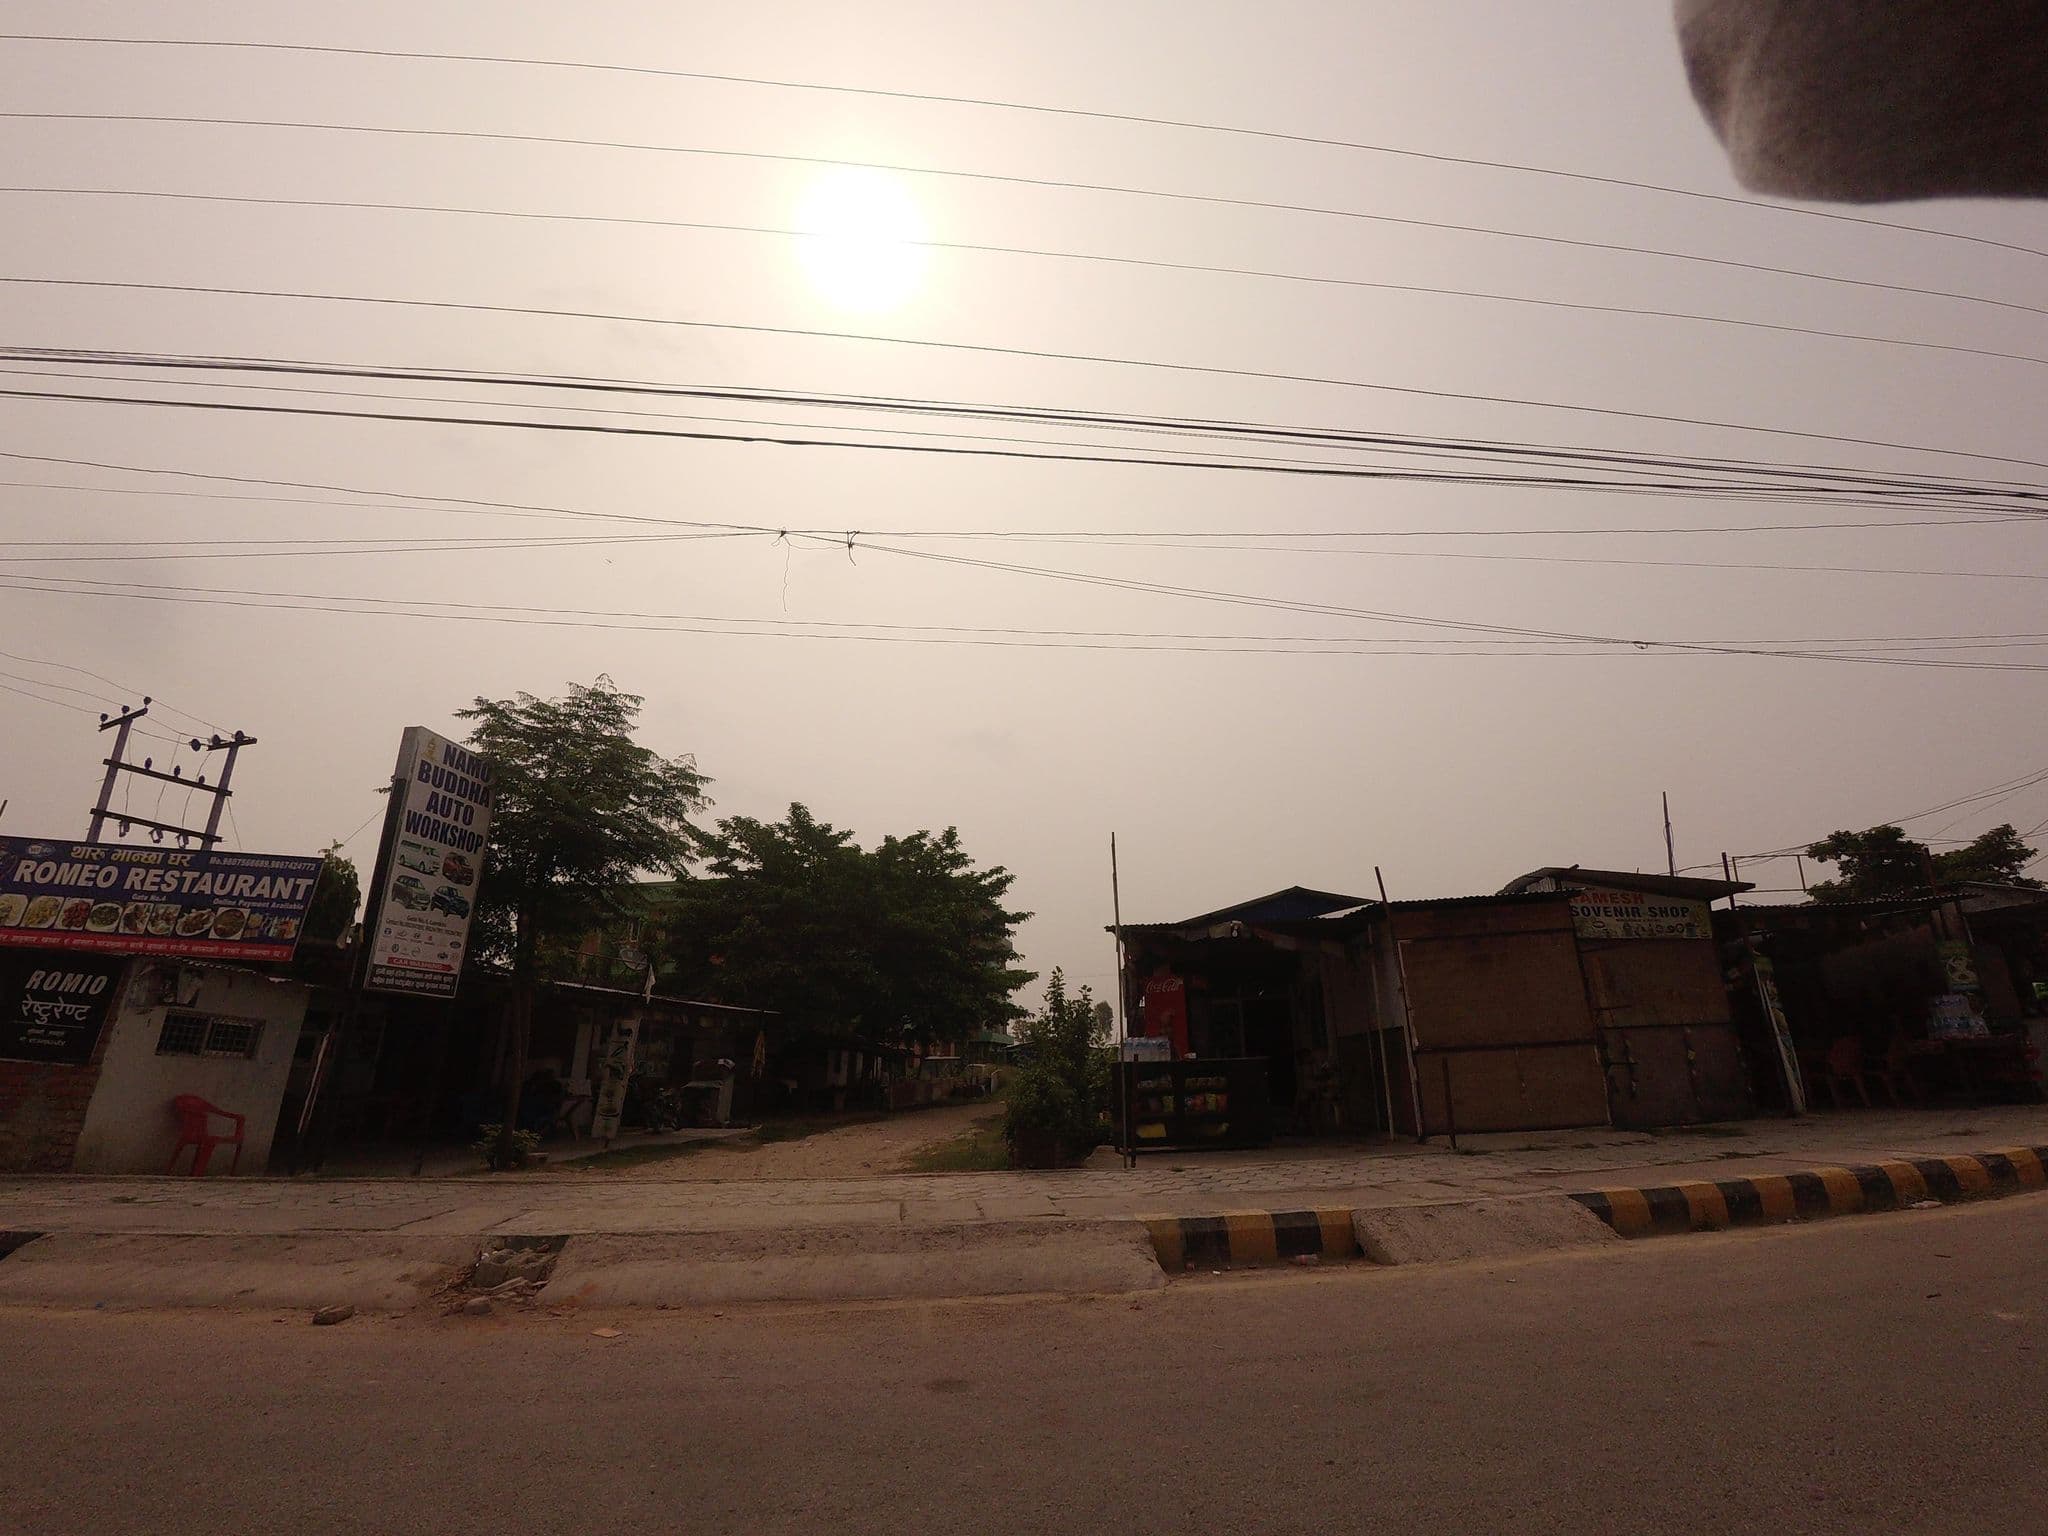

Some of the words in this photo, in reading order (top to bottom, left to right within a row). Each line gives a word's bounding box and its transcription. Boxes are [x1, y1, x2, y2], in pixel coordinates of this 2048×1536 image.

[418, 759, 490, 808] BUDDHA
[426, 791, 475, 826] AUTO
[405, 809, 484, 854] WORKSHOP
[168, 853, 196, 867] घर
[13, 859, 119, 889] ROMEO
[123, 867, 314, 901] RESTAURANT
[1570, 905, 1642, 918] SOVENIR
[1648, 906, 1690, 918] SHOP
[25, 969, 109, 995] ROMIO
